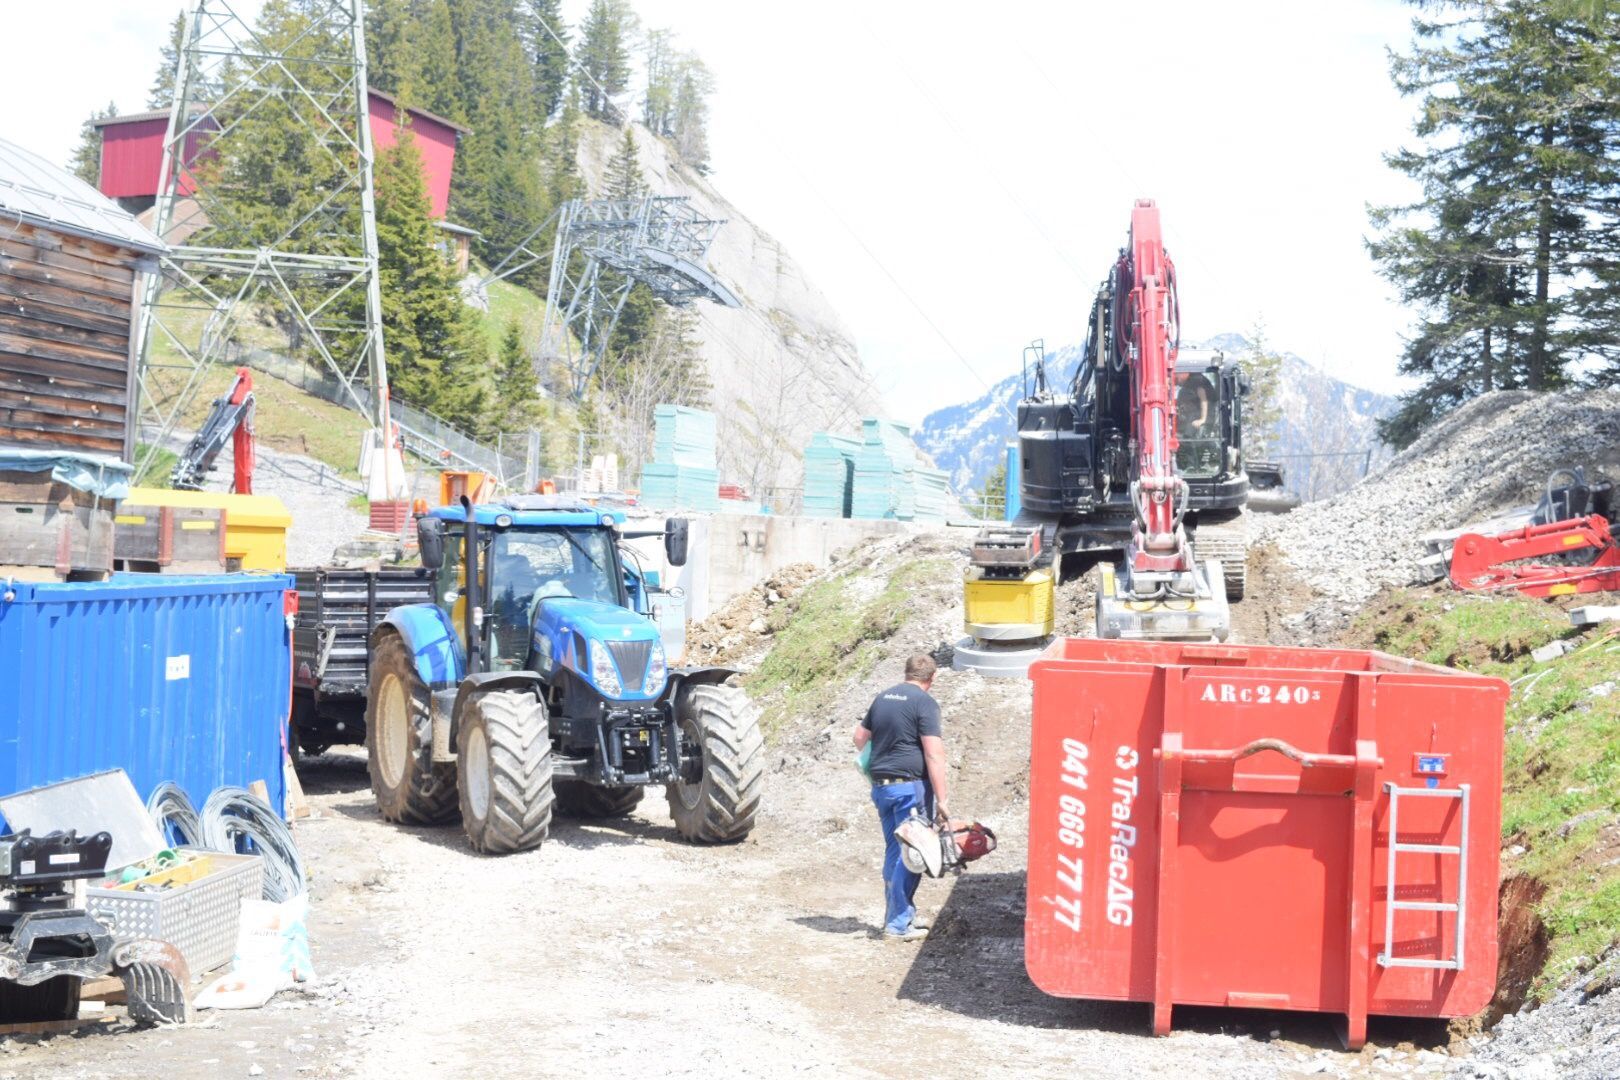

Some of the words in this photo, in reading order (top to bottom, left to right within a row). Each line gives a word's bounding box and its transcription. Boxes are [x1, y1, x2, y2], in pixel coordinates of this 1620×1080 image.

[1061, 737, 1089, 791] 041
[1058, 794, 1087, 849] 666
[1056, 853, 1083, 893] 77
[1054, 894, 1081, 933] 77
